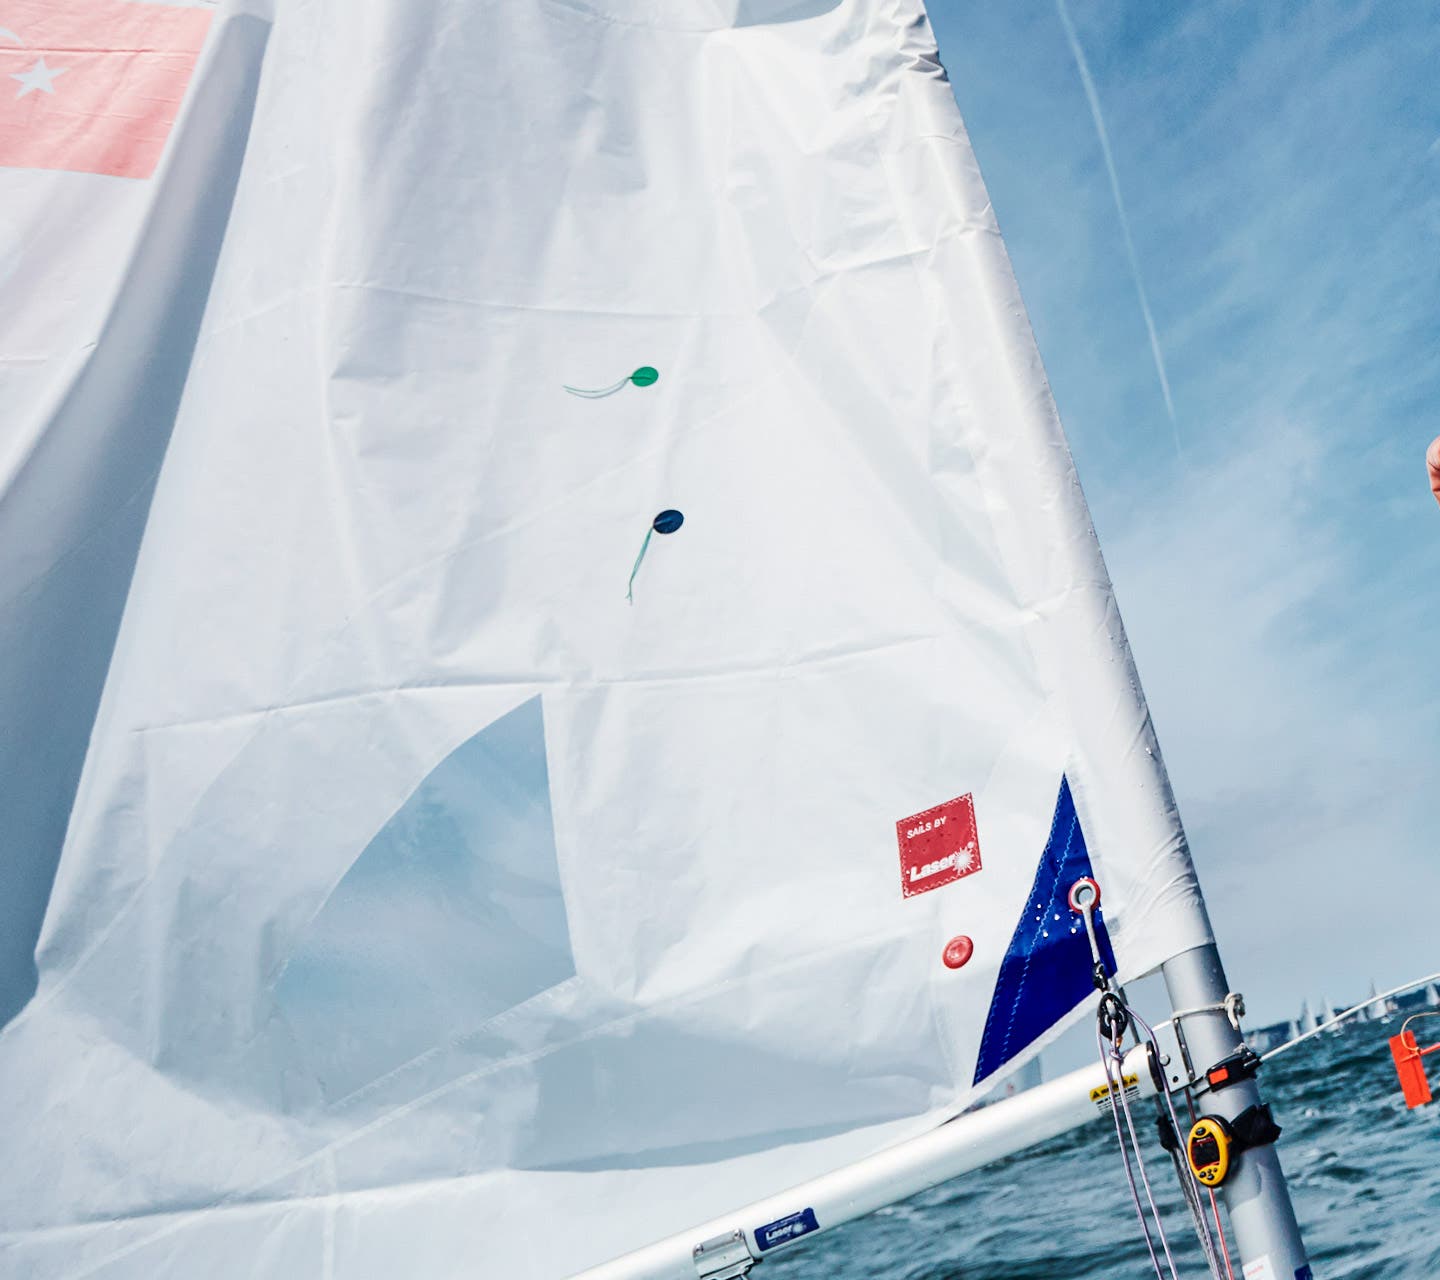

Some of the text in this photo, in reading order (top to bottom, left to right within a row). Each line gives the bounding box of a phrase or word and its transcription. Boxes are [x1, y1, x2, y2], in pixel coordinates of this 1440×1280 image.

[906, 816, 947, 839] SAILS BY
[909, 852, 957, 882] Laser
